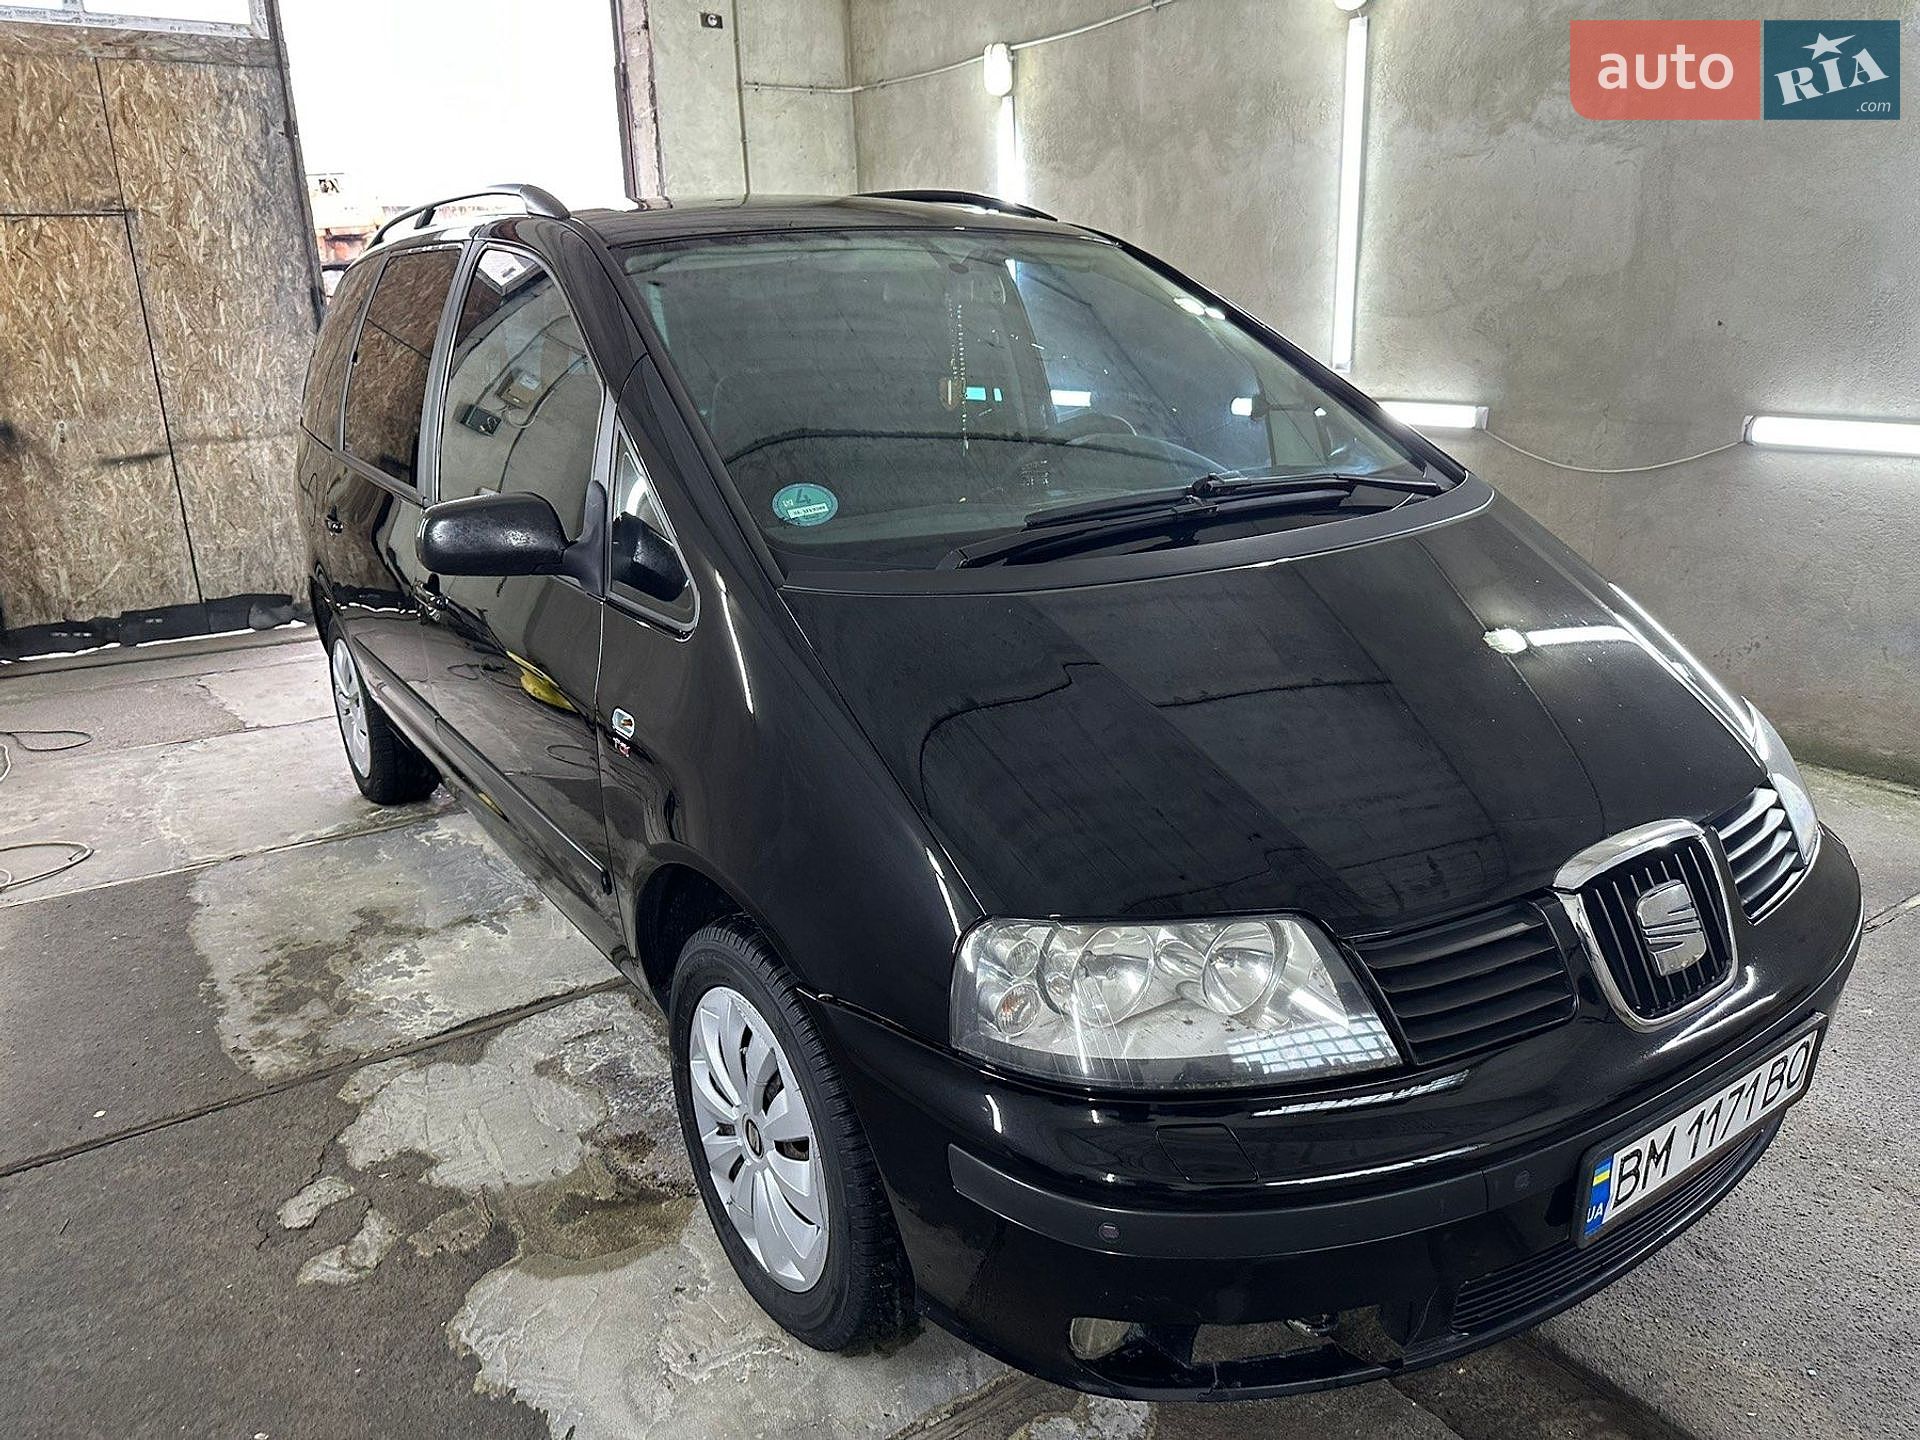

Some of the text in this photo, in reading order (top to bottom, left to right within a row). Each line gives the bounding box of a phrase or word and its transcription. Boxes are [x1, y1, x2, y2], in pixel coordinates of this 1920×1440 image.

[1612, 1039, 1811, 1210] BM 1171 BO
[1586, 1202, 1604, 1224] UA
